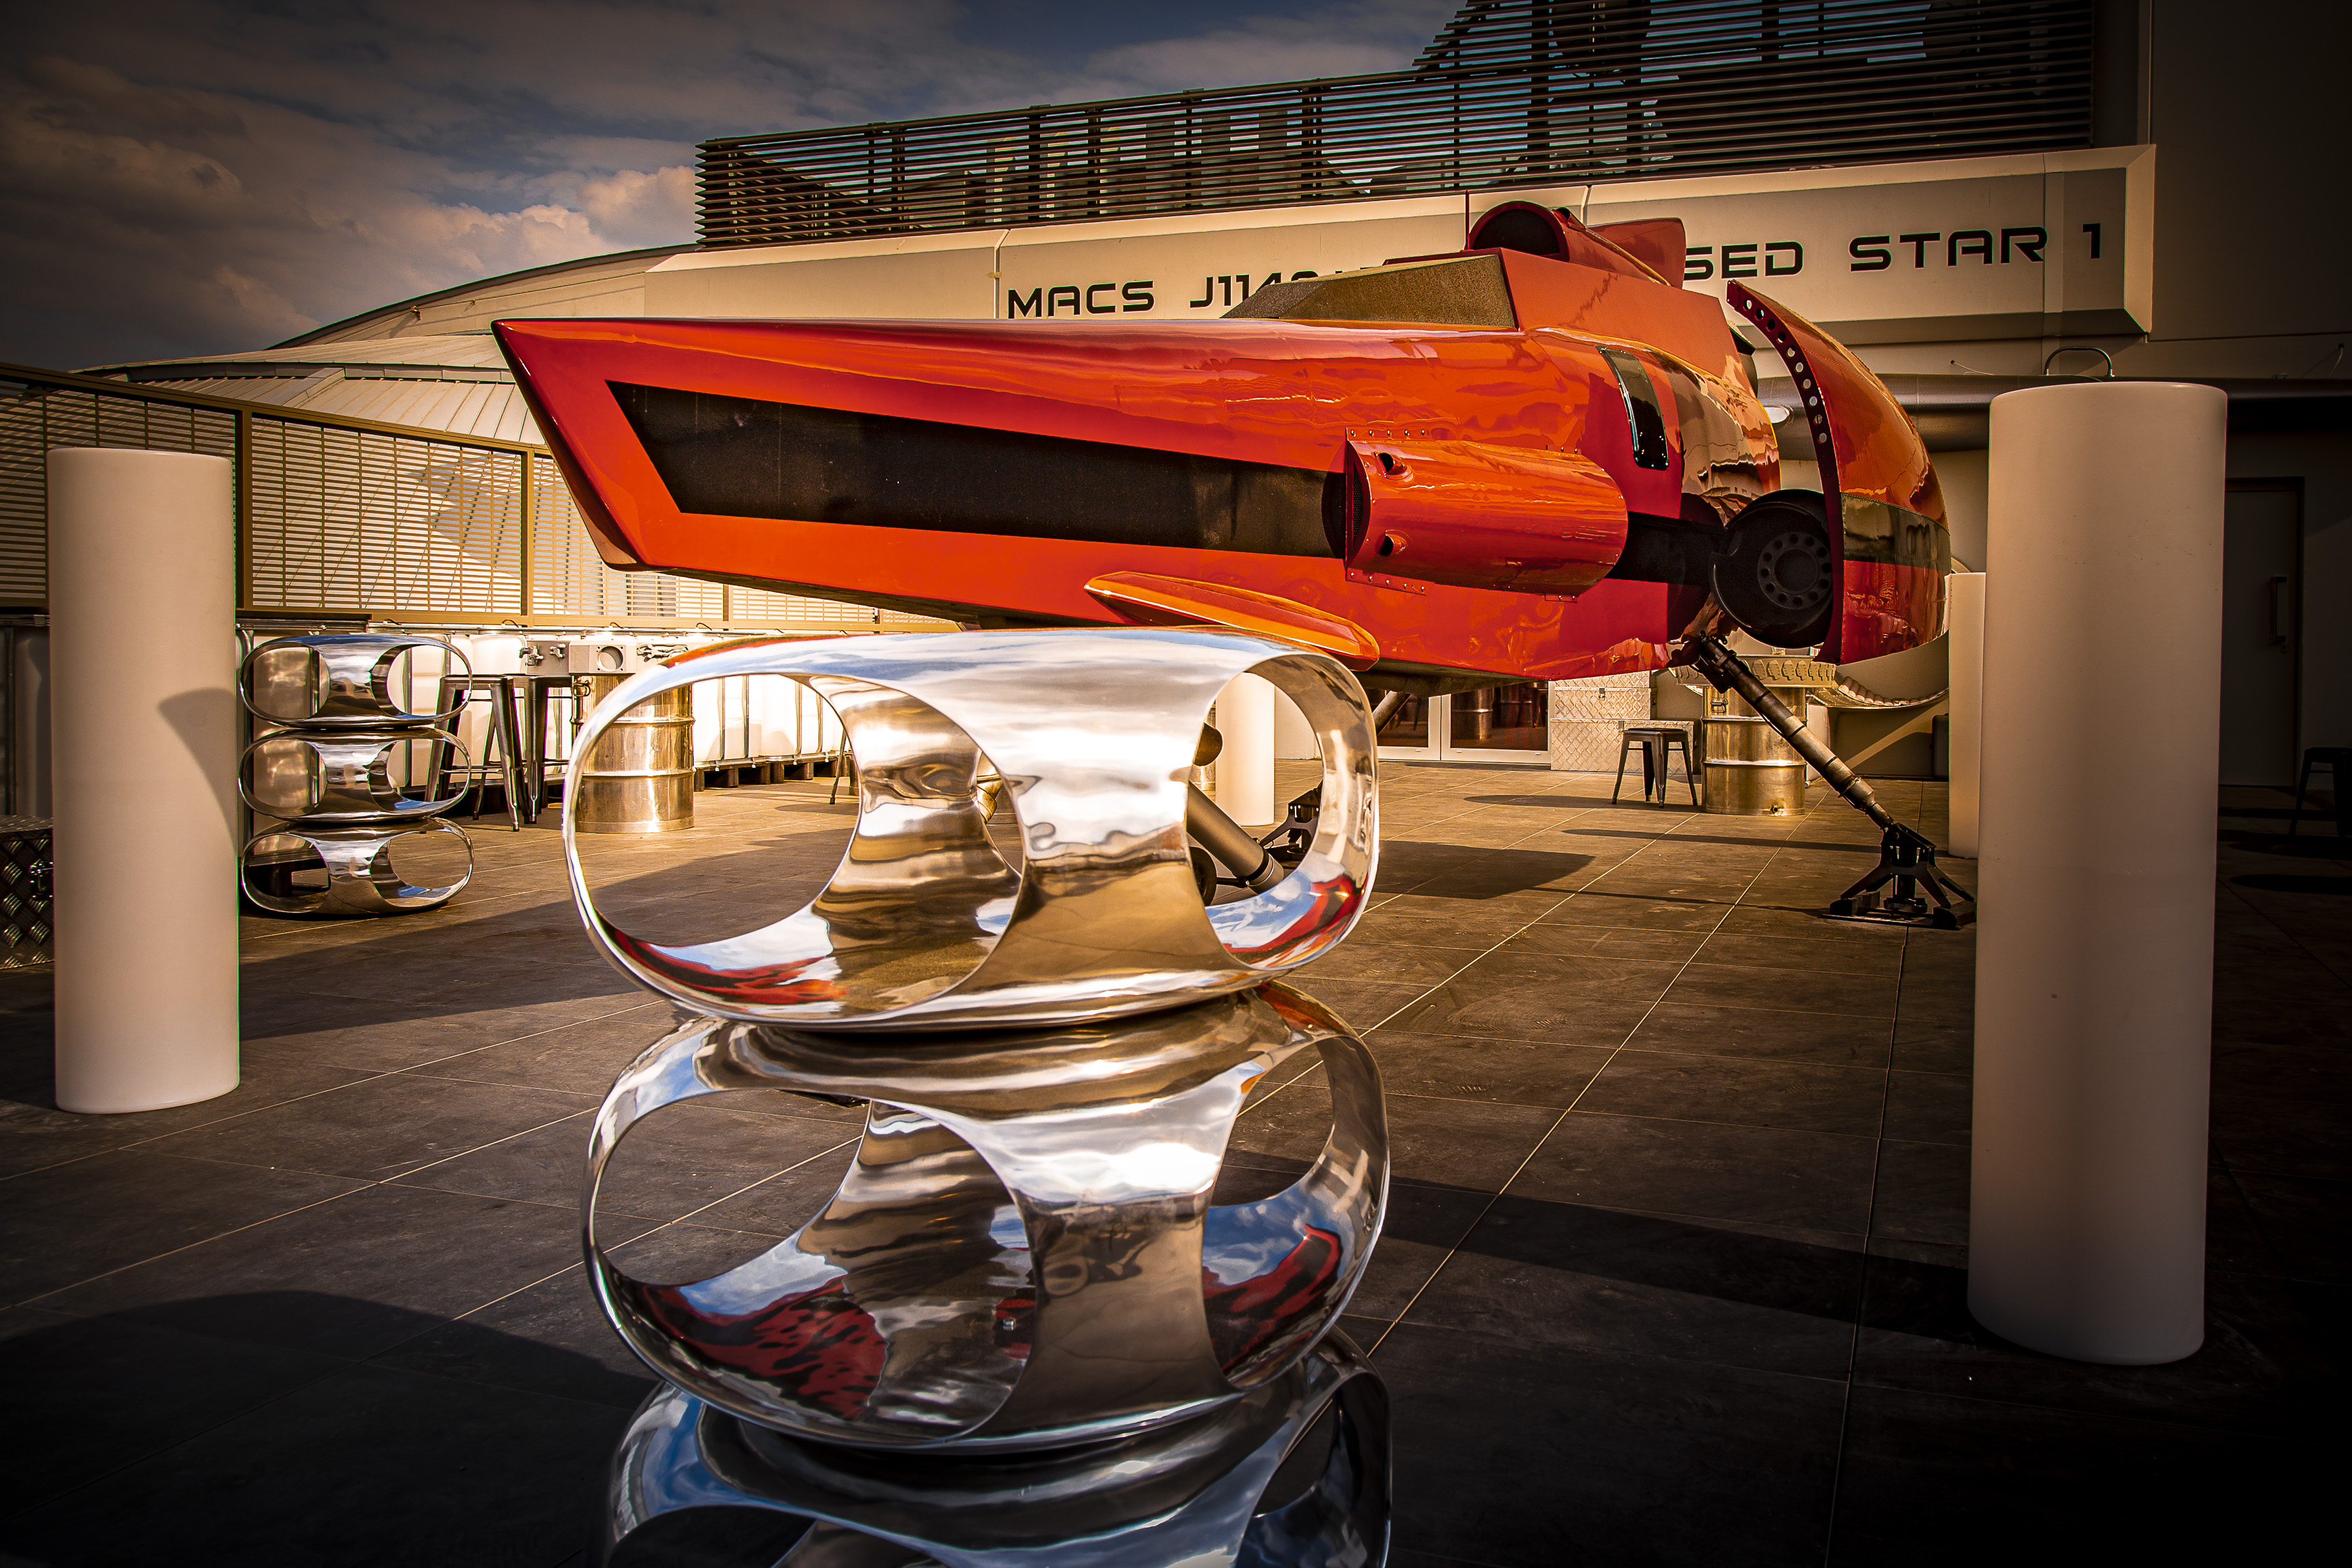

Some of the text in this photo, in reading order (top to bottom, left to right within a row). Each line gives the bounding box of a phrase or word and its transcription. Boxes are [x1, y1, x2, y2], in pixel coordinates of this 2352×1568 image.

[1007, 280, 1155, 319] MACS
[1849, 225, 2049, 272] STAR
[2082, 222, 2102, 259] 1
